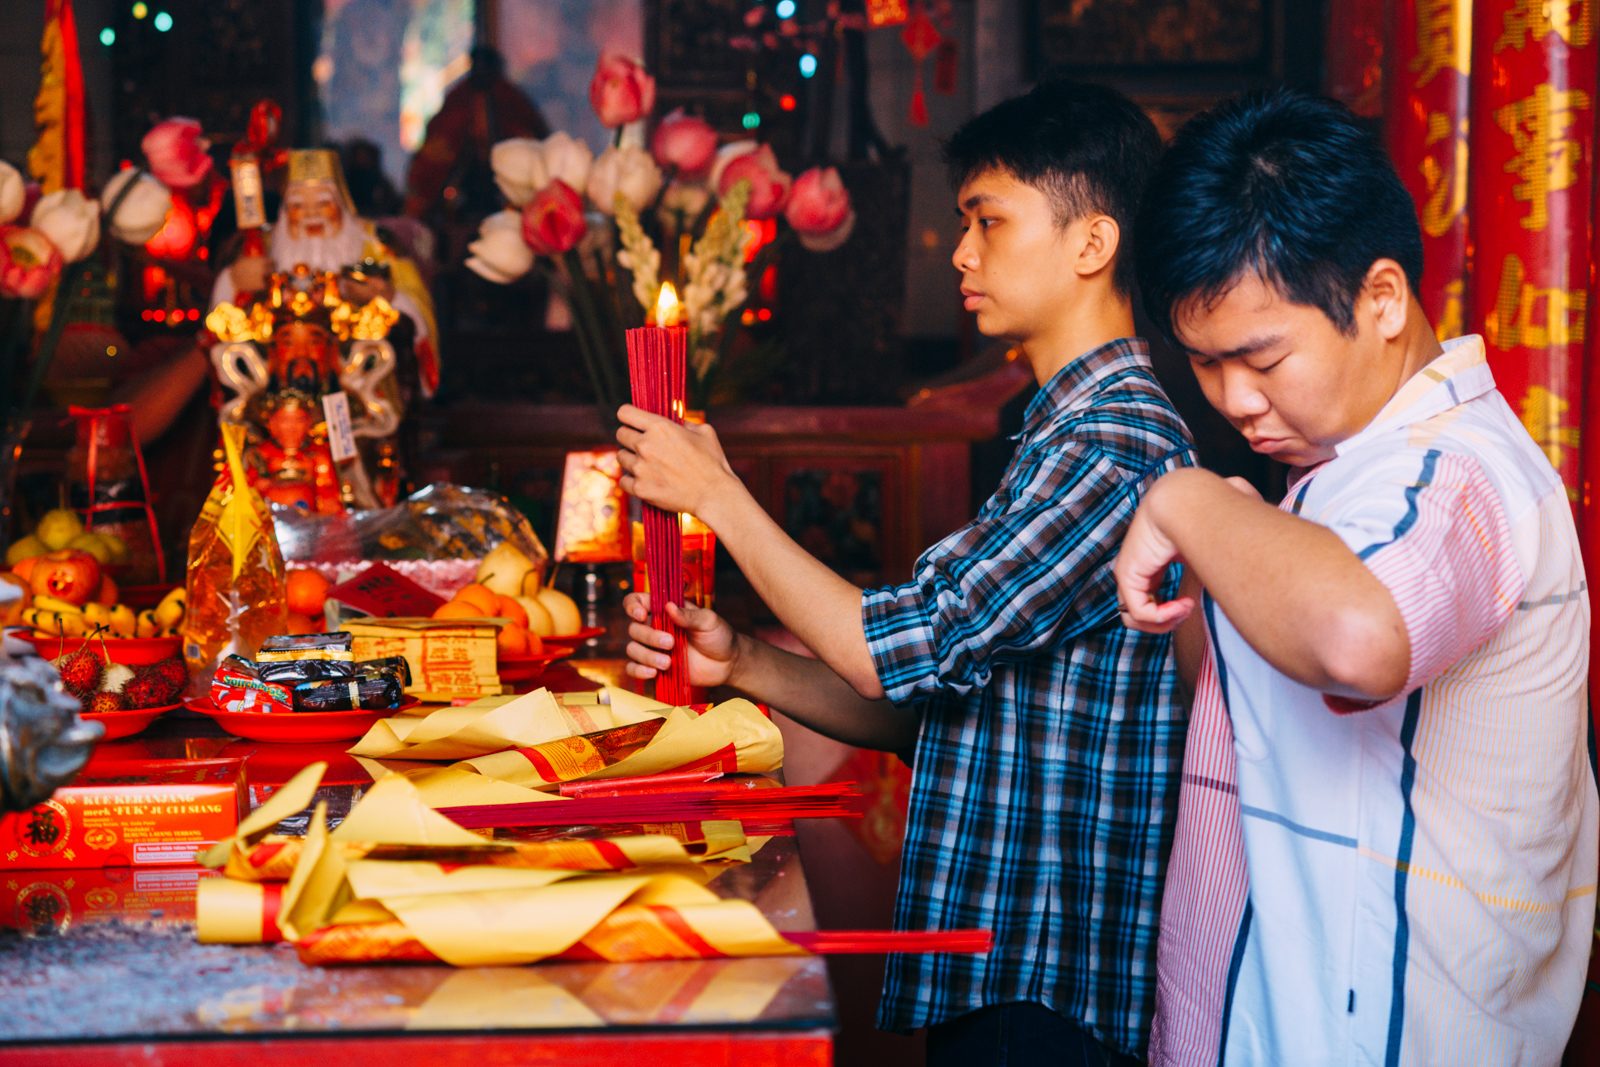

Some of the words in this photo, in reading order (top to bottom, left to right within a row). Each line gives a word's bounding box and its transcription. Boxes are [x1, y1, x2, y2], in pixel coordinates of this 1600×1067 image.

[83, 795, 111, 805] KUE
[114, 794, 195, 804] KERANJANG
[83, 808, 111, 816] merk
[150, 806, 164, 814] JU
[188, 804, 222, 814] SIANG
